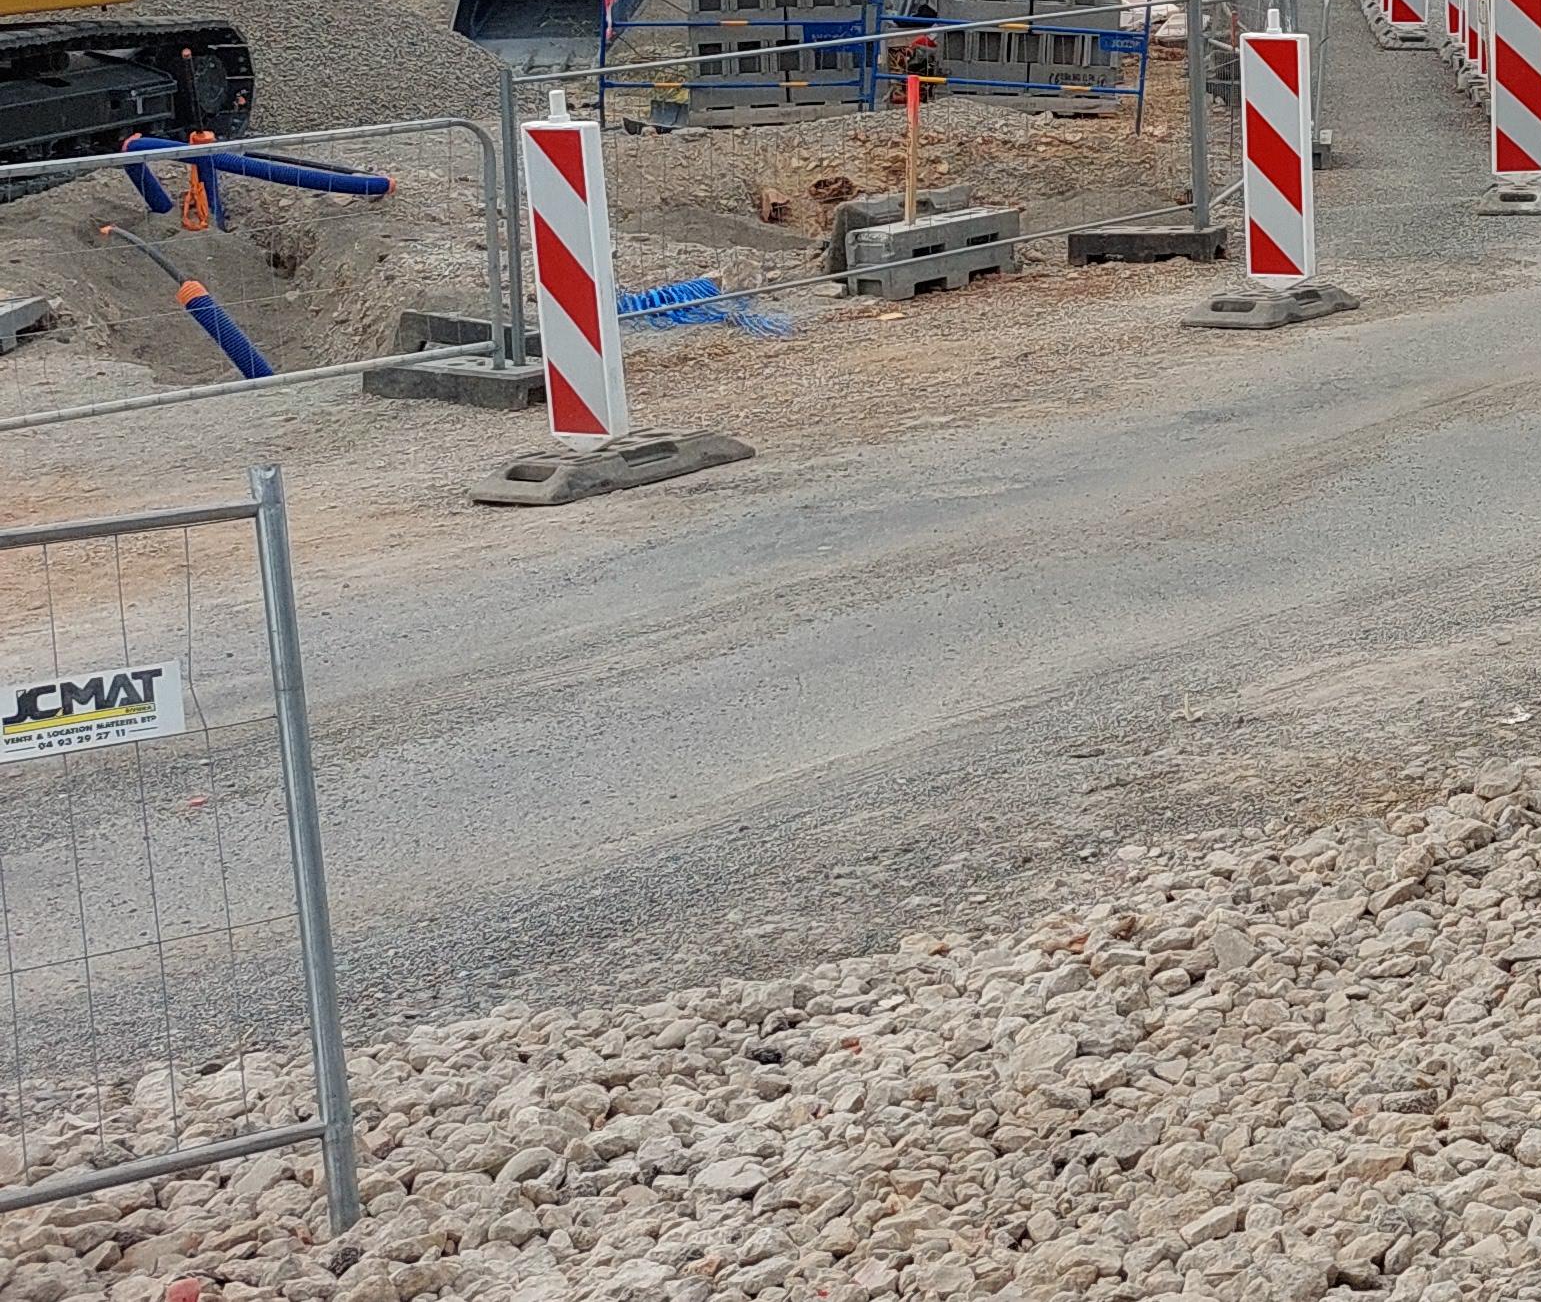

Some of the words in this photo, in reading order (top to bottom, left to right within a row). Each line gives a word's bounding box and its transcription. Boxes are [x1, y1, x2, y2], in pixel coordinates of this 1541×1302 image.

[2, 668, 162, 725] JCMAT
[4, 735, 33, 746] VENTE
[47, 725, 93, 739] LOCATION
[141, 715, 157, 724] BTP
[38, 741, 54, 750] 04
[58, 738, 72, 747] 93
[77, 734, 91, 744] 29
[96, 731, 111, 740] 27
